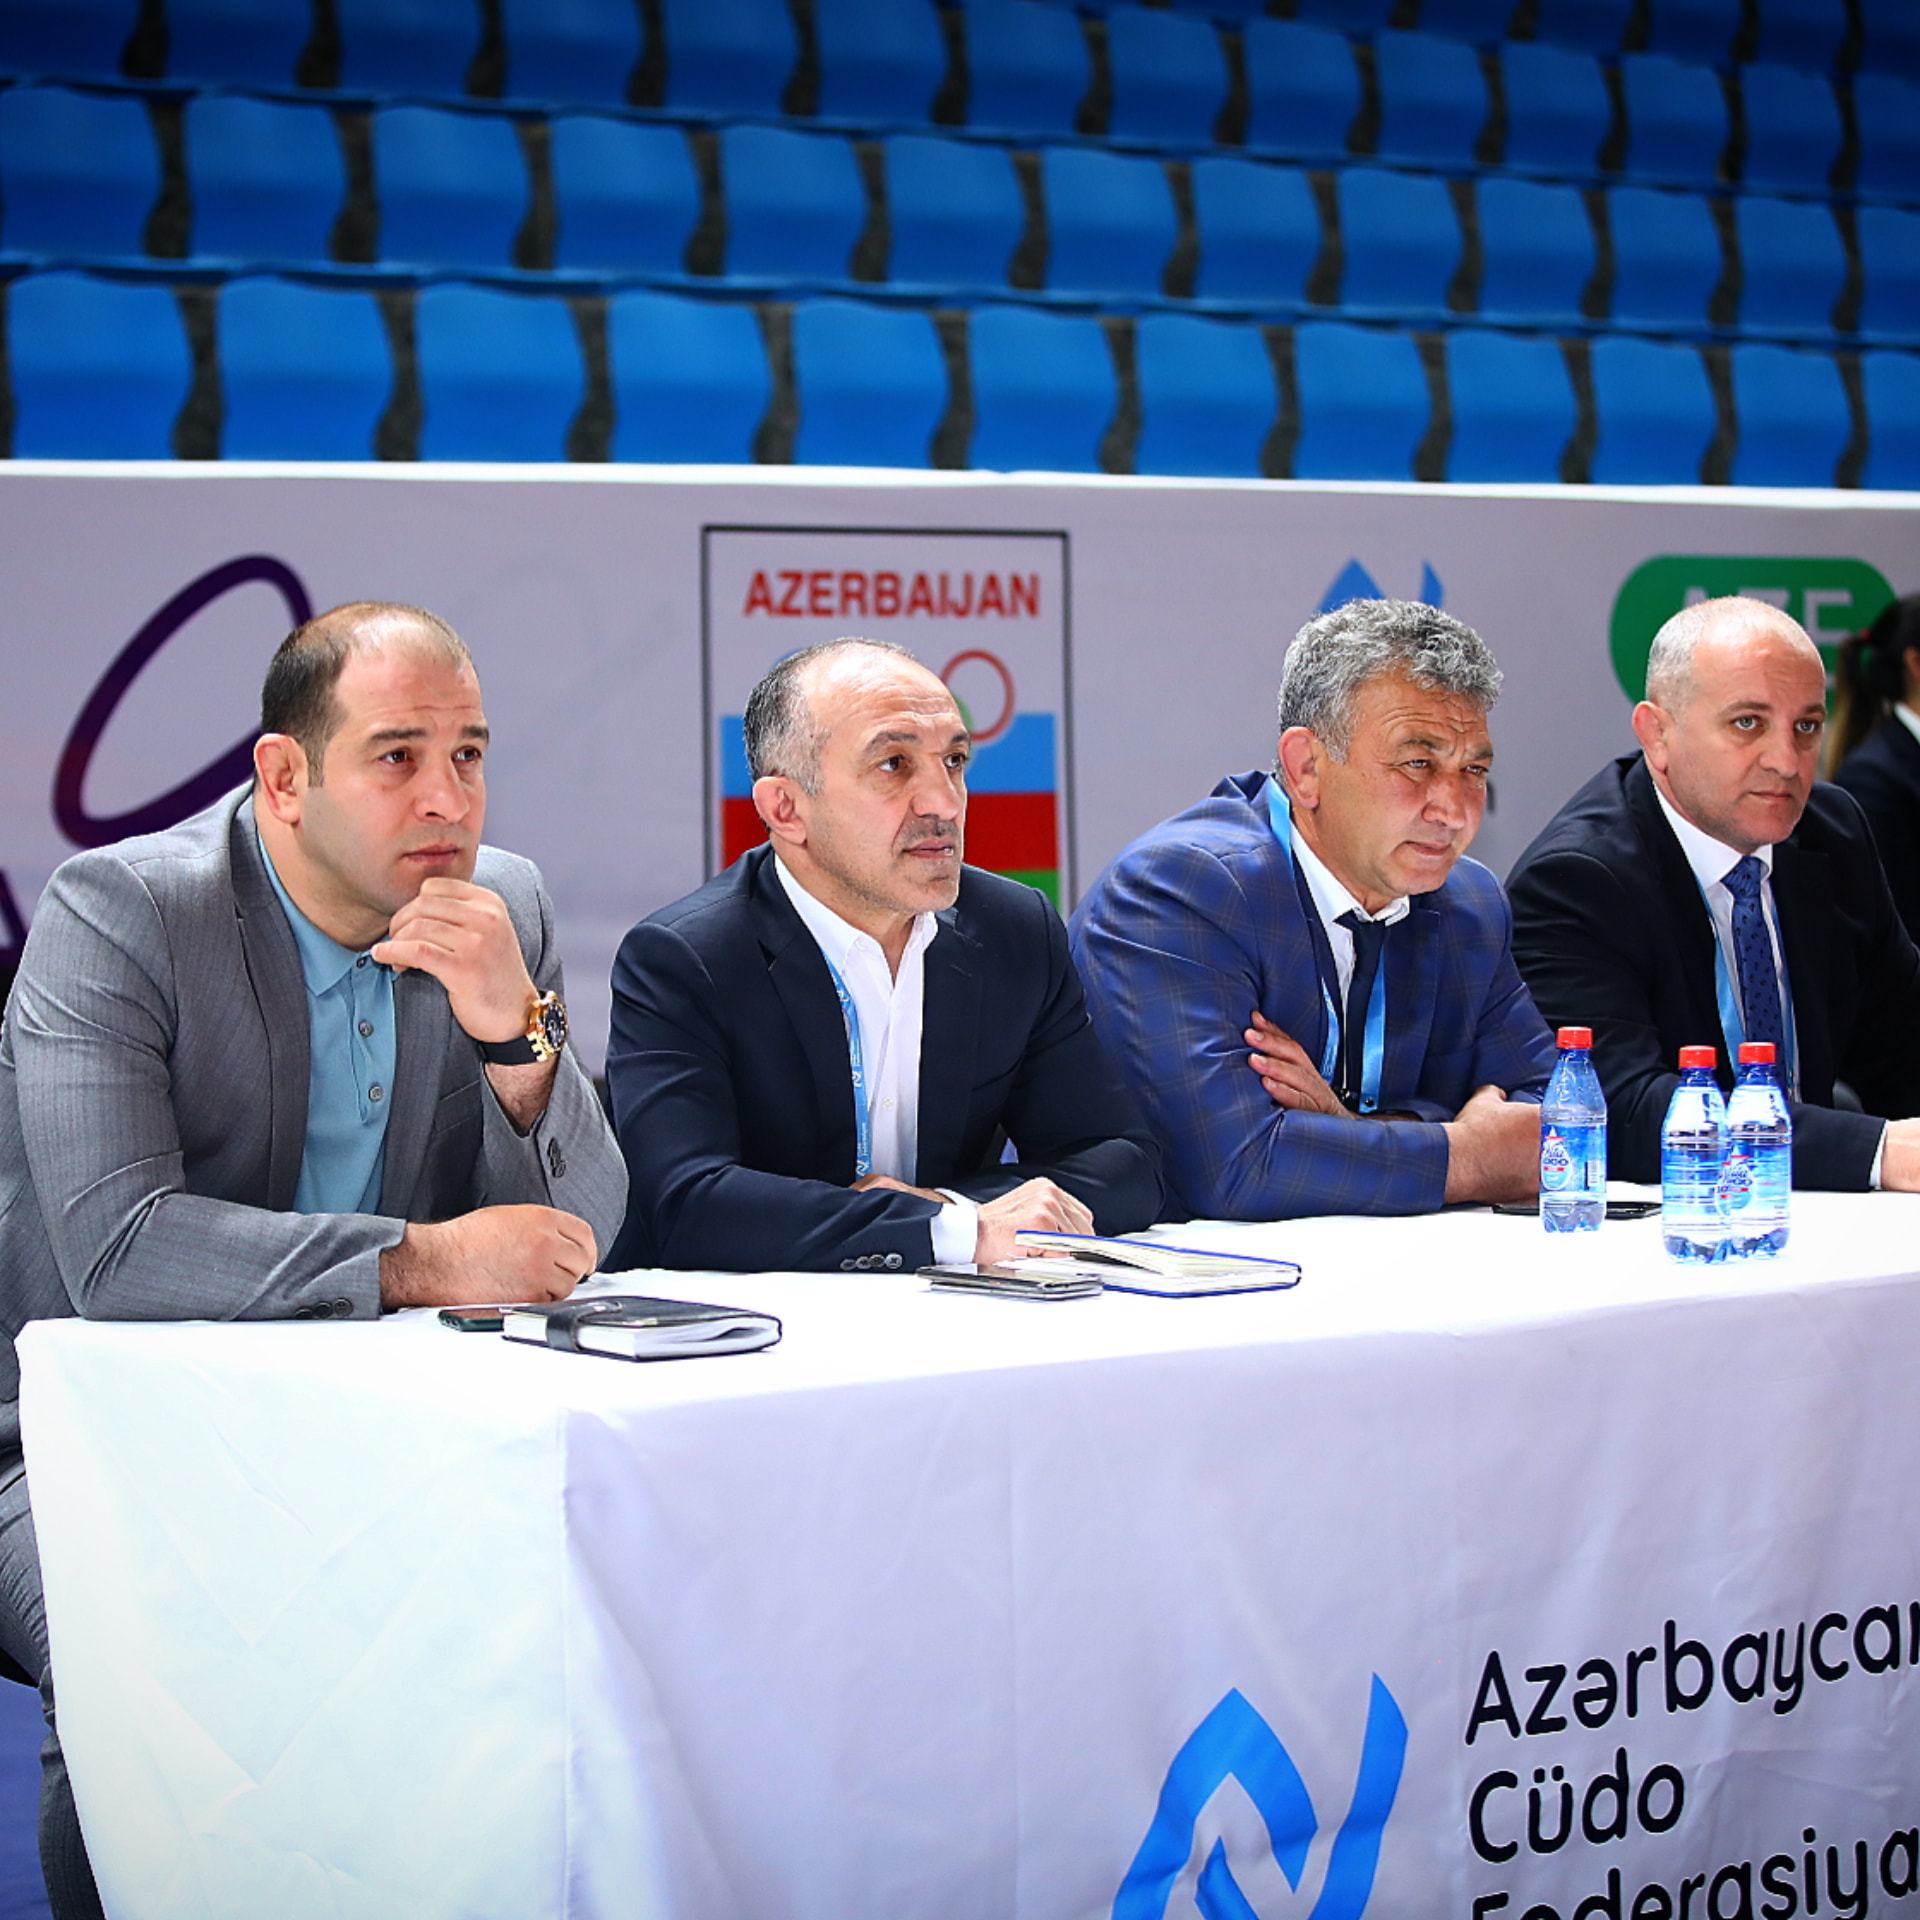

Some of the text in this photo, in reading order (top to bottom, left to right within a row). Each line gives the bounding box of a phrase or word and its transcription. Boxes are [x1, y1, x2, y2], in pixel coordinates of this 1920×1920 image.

[743, 569, 1040, 619] AZERBAIJAN
[1464, 1600, 1920, 1746] Azərbayca
[1468, 1746, 1685, 1864] Cüdo
